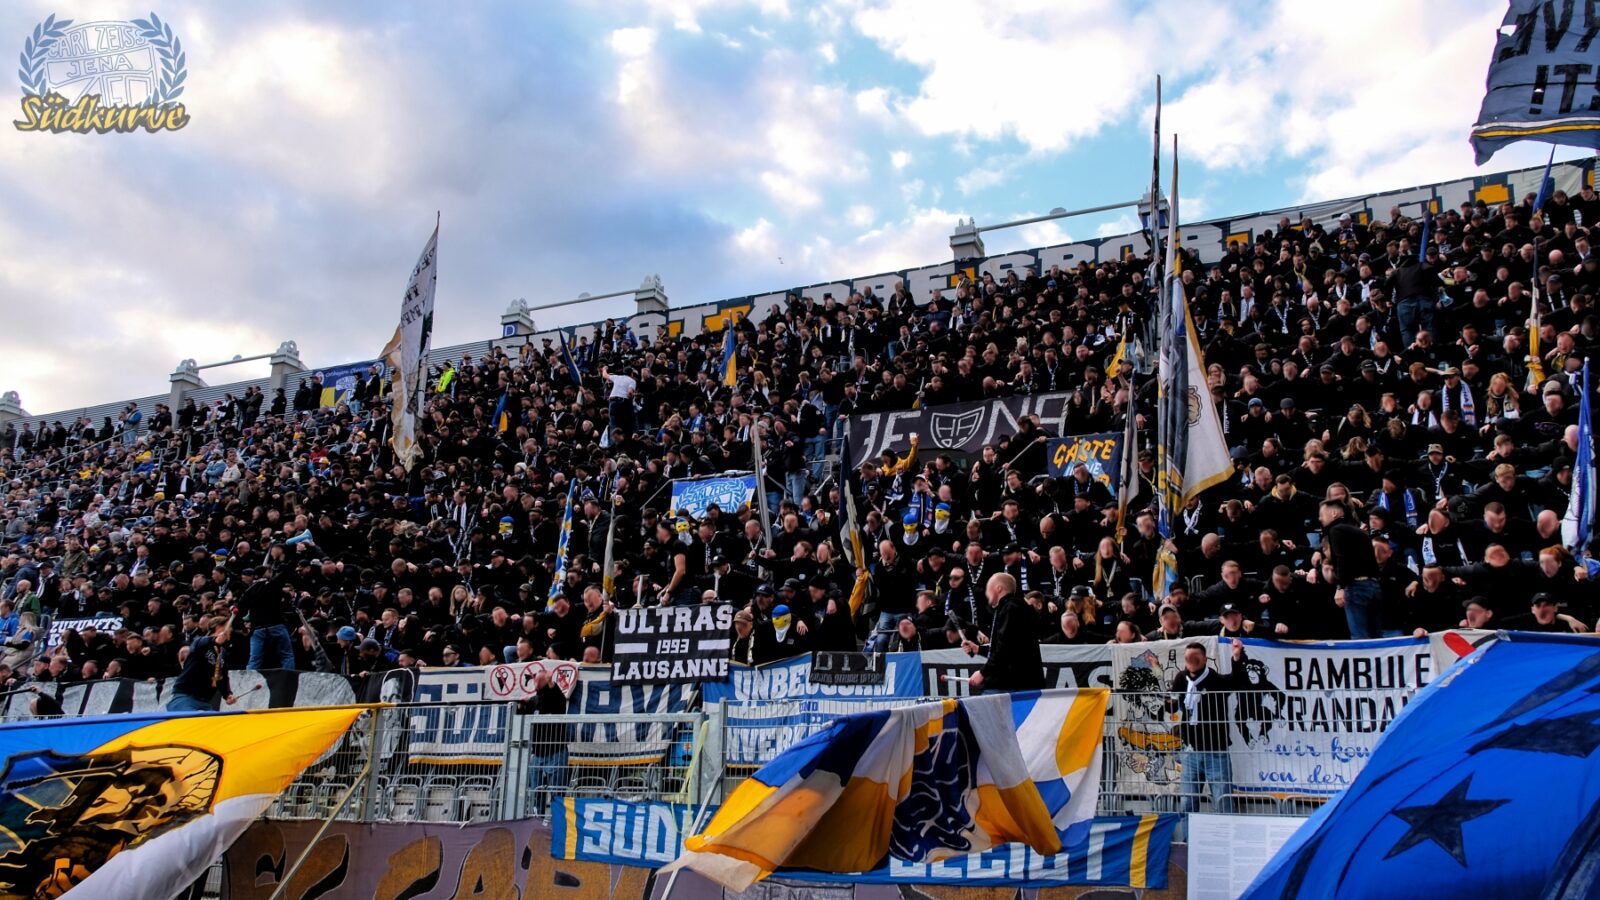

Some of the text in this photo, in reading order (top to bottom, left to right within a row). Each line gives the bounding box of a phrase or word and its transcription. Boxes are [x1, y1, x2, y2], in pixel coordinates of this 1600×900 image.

[1053, 437, 1116, 469] GÄSTE
[50, 617, 124, 634] ZUKUNFTS
[618, 604, 733, 634] ULTRAS
[655, 638, 690, 655] 1993
[612, 657, 730, 682] LAUSANNE
[1284, 654, 1432, 690] BAMBULE
[1259, 764, 1350, 784] von der
